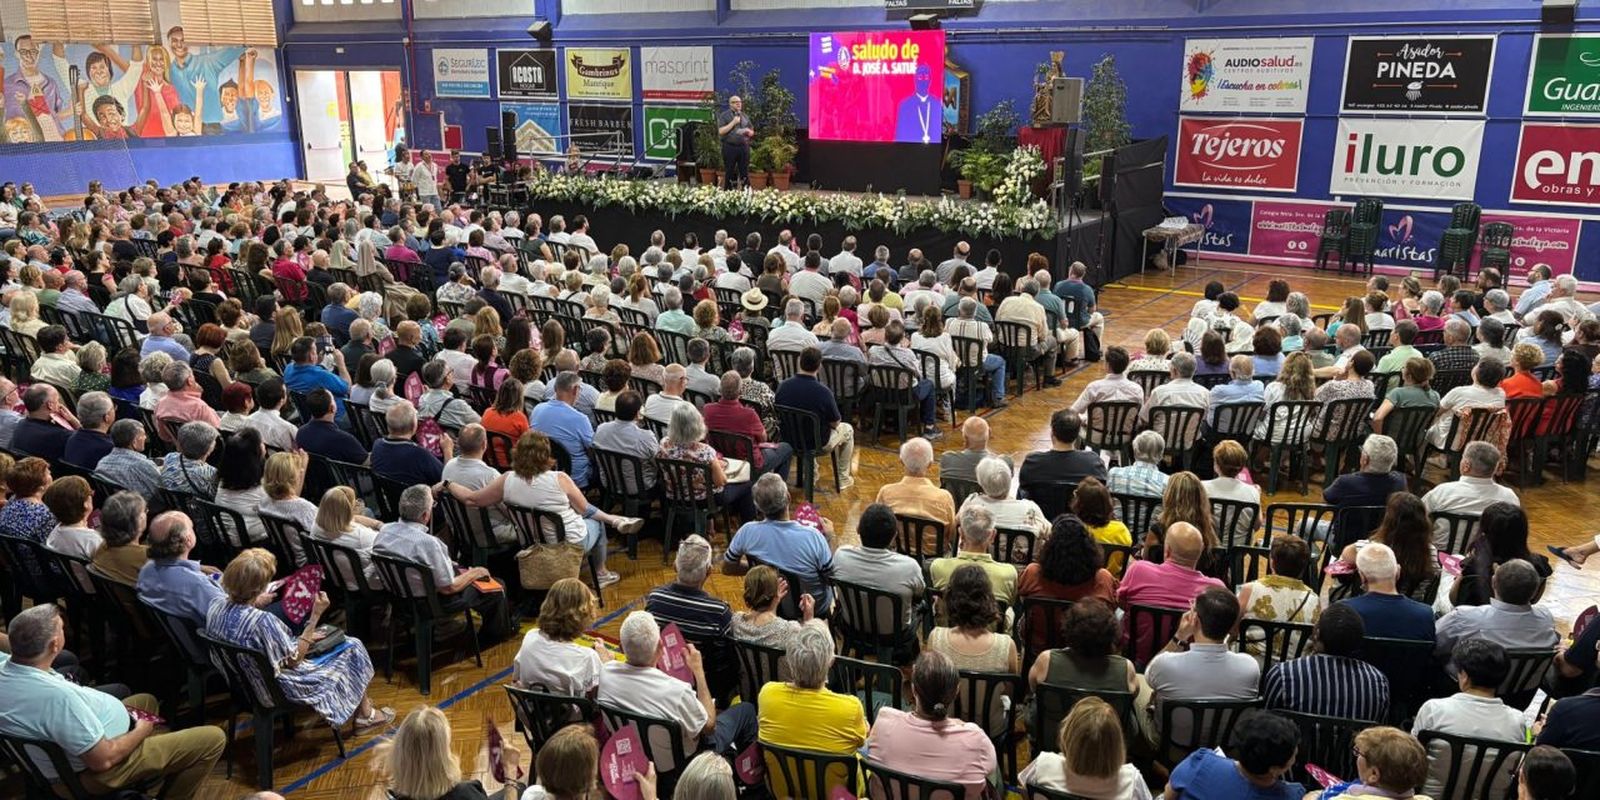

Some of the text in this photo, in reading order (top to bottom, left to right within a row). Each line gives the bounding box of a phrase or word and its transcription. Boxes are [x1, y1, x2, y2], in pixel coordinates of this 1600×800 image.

[852, 38, 920, 60] saludo de
[1396, 43, 1444, 60] Asador
[645, 54, 709, 76] masprint
[862, 59, 881, 76] JOSÉ
[1376, 62, 1456, 78] PINEDA
[512, 66, 543, 83] ACOSTA
[583, 79, 614, 88] Manrique
[1255, 82, 1266, 90] en
[1544, 77, 1600, 101] Gua
[1192, 132, 1286, 162] Tejeros
[1345, 133, 1466, 178] iluro
[1202, 172, 1212, 182] La
[1213, 173, 1232, 182] vida
[1244, 174, 1267, 184] dulce
[1344, 176, 1397, 185] PREVENCIÓN
[1410, 180, 1461, 188] FORMACIÓN
[1542, 184, 1594, 197] obras y
